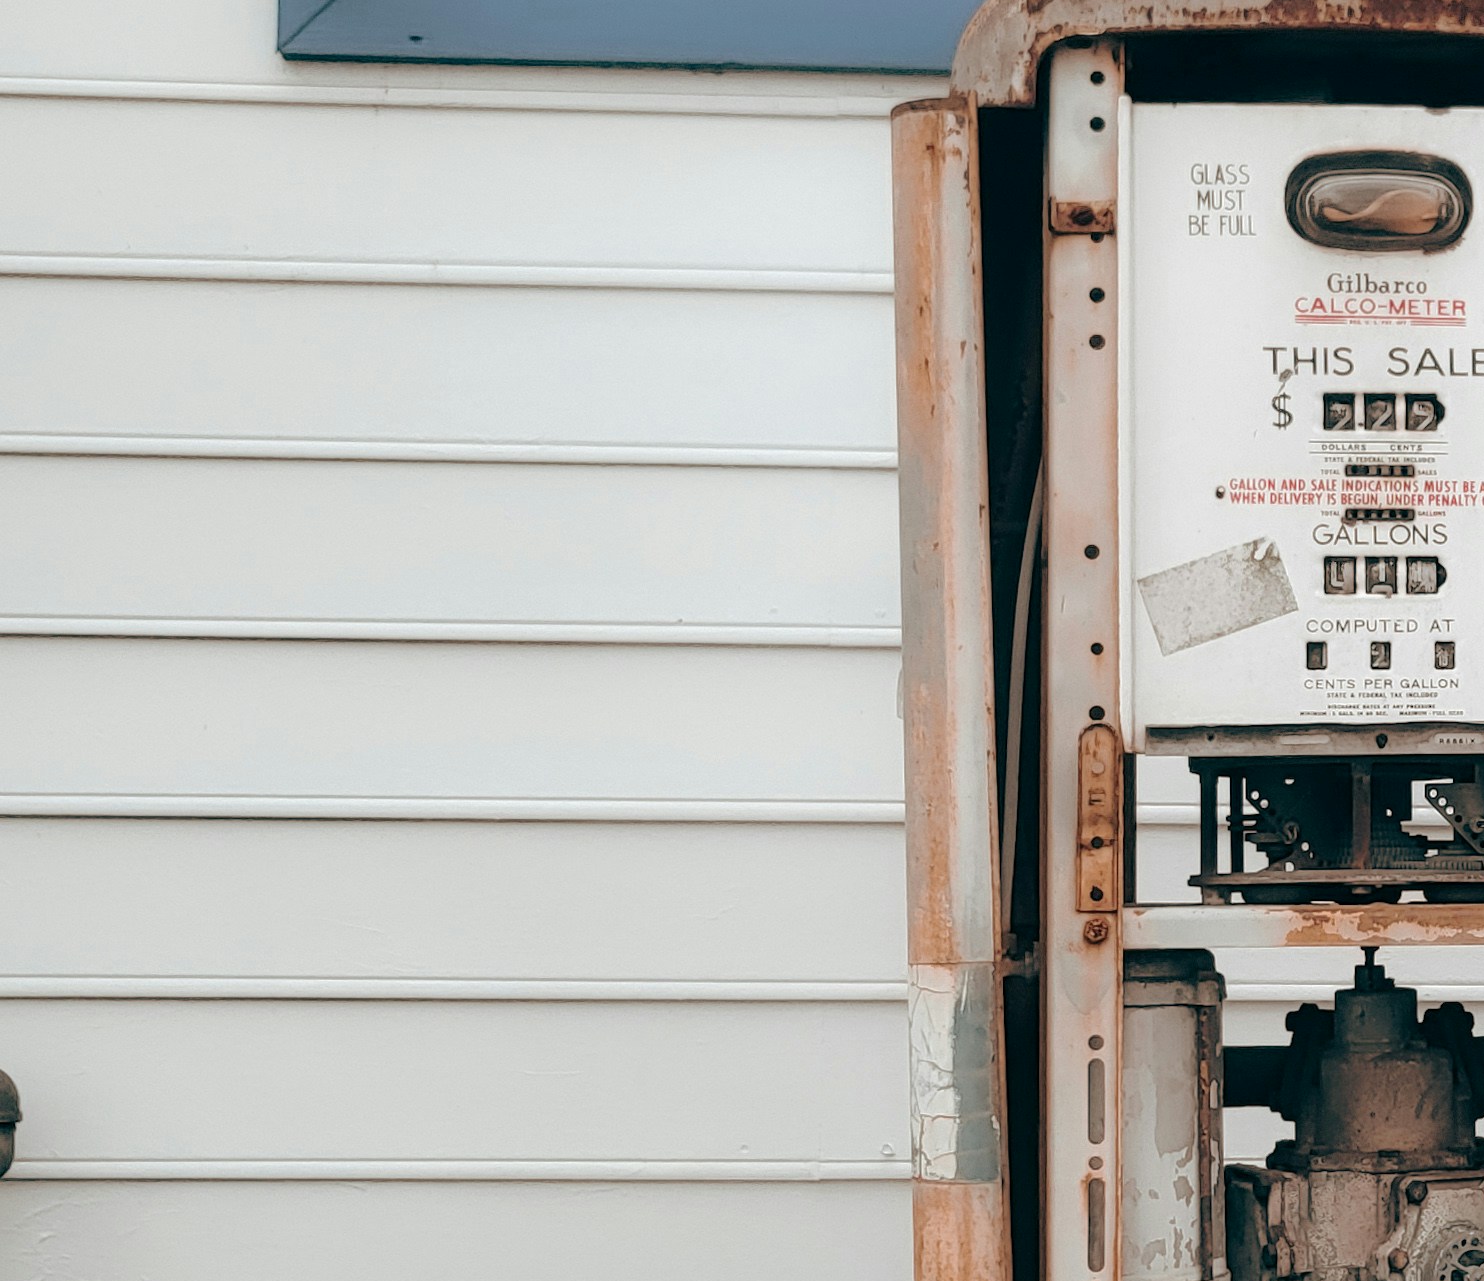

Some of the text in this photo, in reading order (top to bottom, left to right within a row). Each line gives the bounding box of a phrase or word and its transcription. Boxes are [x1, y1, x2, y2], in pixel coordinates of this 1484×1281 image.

[1190, 163, 1250, 185] GLASS
[1197, 190, 1245, 211] MUST
[1188, 215, 1256, 236] BE FULL
[1327, 273, 1428, 294] Gilbarco
[1295, 297, 1467, 317] CALCO-METER
[1263, 347, 1355, 376] THIS
[1272, 392, 1294, 431] $
[1321, 444, 1423, 452] DOLLARS CENTS
[1229, 478, 1276, 491] GALLON
[1281, 479, 1306, 491] AND
[1311, 479, 1337, 492] SALE
[1341, 480, 1419, 493] INDICATIONS
[1424, 481, 1458, 493] MUST
[1463, 481, 1475, 494] BE
[1230, 492, 1265, 505] WHEN
[1270, 493, 1322, 505] DELIVERY
[1327, 493, 1336, 505] IS
[1341, 493, 1383, 508] BEGUN,
[1387, 494, 1424, 507] UNDER
[1429, 494, 1477, 507] PENALTY
[1312, 524, 1448, 545] GALLONS
[1306, 619, 1455, 633] COMPUTED AT
[1304, 679, 1459, 689] CENTS PER GALLON
